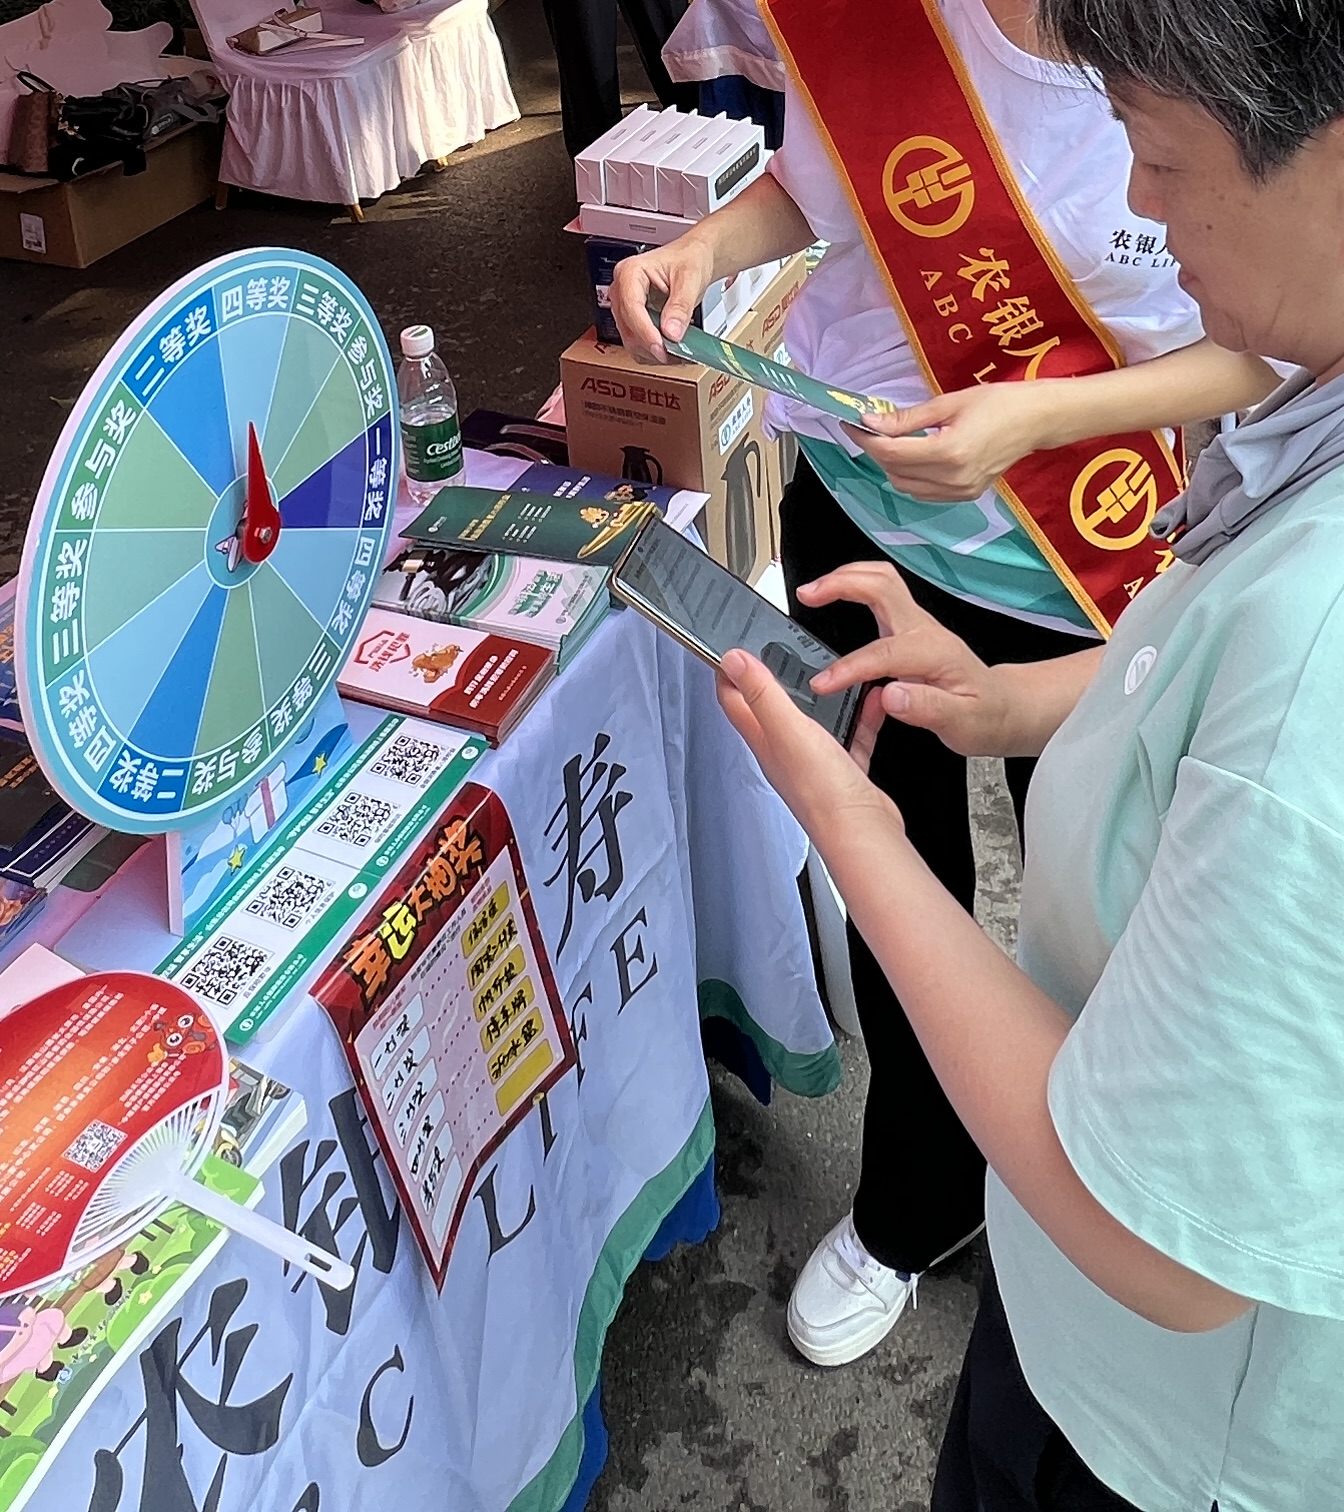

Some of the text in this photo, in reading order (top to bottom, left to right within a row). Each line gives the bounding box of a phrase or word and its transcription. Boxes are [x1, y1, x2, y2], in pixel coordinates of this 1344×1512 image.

[221, 277, 290, 322] 四等奖
[1105, 251, 1142, 268] ABC
[296, 283, 354, 342] 三等奖
[920, 268, 974, 344] ABC
[135, 303, 210, 398] 二等奖
[350, 335, 386, 419] 参与奖
[580, 376, 682, 412] ASD 爱仕达
[72, 398, 136, 520] 参与奖
[365, 428, 387, 521] 一等奖
[50, 537, 88, 665] 三等奖
[332, 537, 375, 635] 四等奖
[59, 669, 116, 772] 四等奖
[271, 642, 331, 737] 三等奖
[109, 750, 184, 802] 二等奖
[191, 727, 262, 796] 参与奖
[346, 816, 487, 998] 幸运大抽奖
